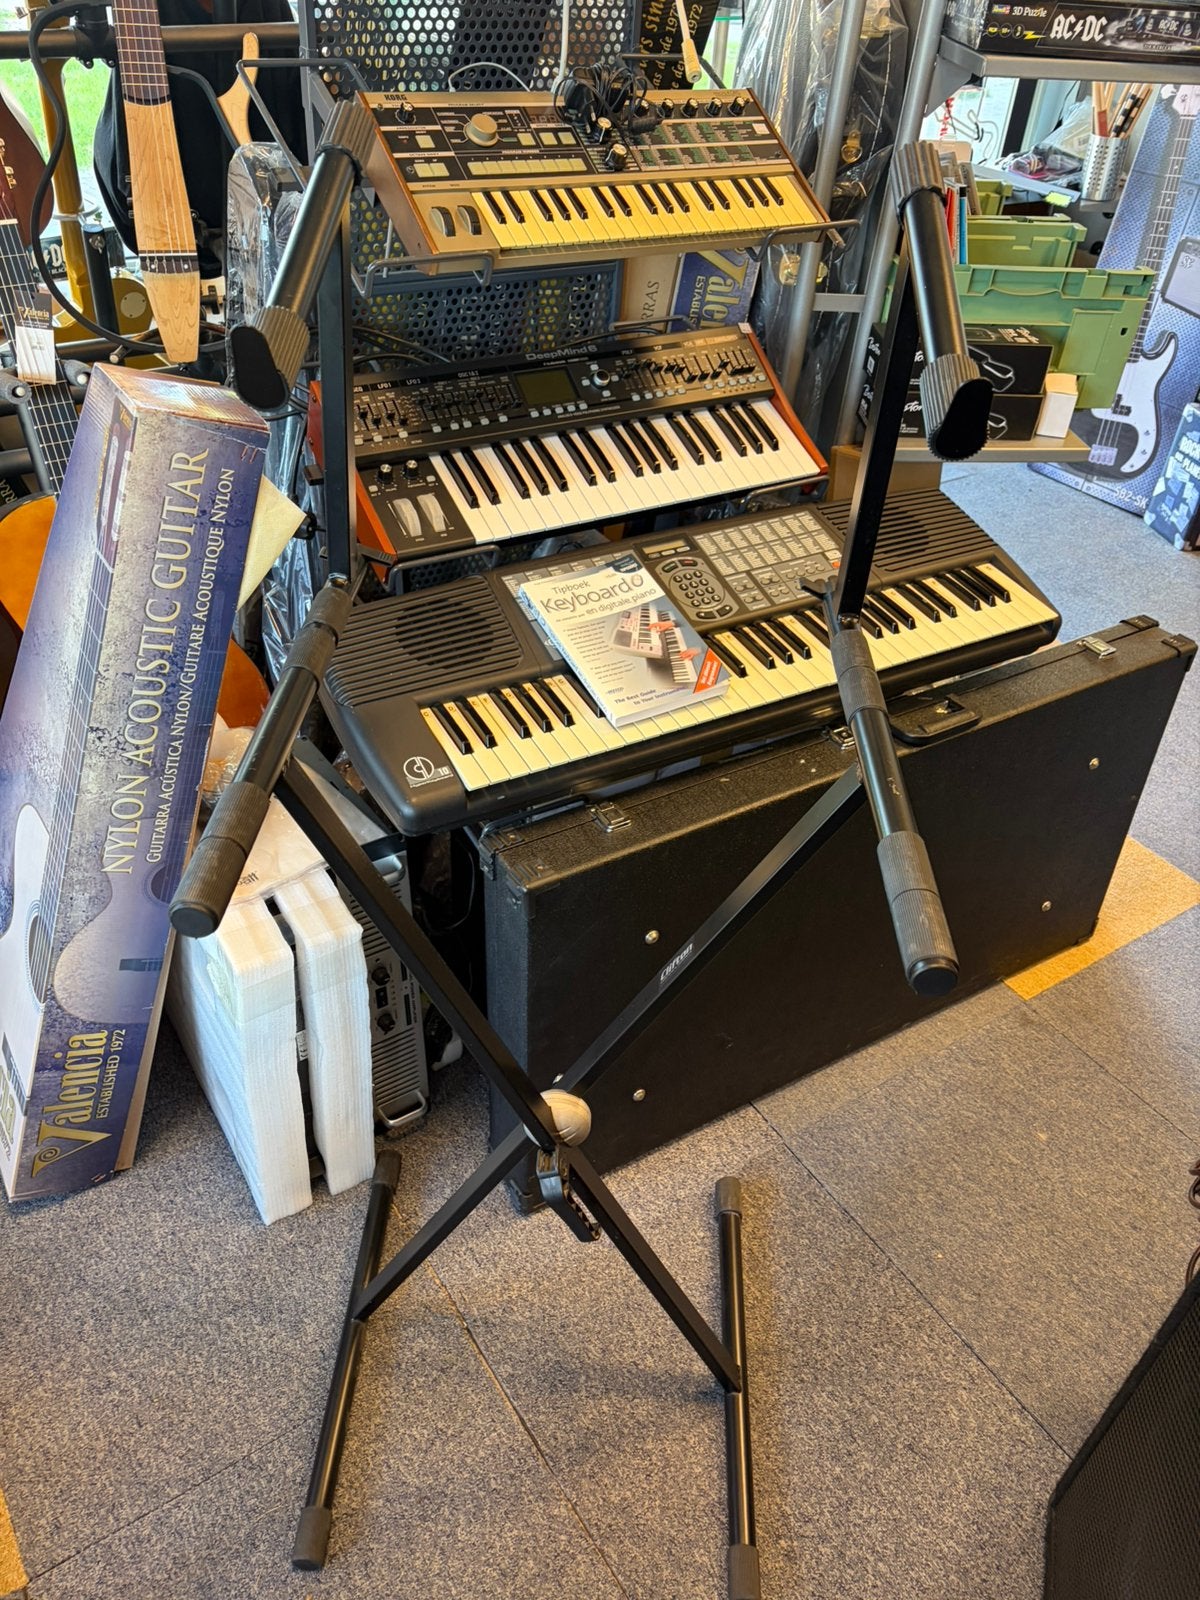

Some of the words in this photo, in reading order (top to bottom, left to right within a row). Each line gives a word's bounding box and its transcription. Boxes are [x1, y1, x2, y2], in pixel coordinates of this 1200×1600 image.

[643, 0, 665, 32] sin
[689, 4, 703, 36] 1972
[1012, 6, 1024, 16] 3D
[656, 36, 673, 70] dsde
[687, 275, 706, 330] ESTABLIS
[698, 249, 749, 328] Vale
[525, 347, 587, 361] DeepMind
[150, 448, 209, 590] GUITAR
[215, 468, 235, 524] NYLON
[192, 527, 226, 622] ACOUSTIQUE
[540, 577, 632, 614] Keyboard
[552, 579, 591, 596] Tipboek
[585, 607, 599, 616] en
[598, 597, 632, 614] digitale
[631, 587, 657, 605] piano
[121, 598, 182, 768] ACOUSTIC
[170, 623, 206, 739] NYLON/GUITARE
[161, 740, 184, 802] ACÚSTICA
[101, 774, 151, 874] NYLON
[146, 800, 172, 864] GUITARRA
[31, 1029, 112, 1178] Valencia
[96, 1055, 120, 1120] ESTABLISHED
[110, 1028, 126, 1053] 1972
